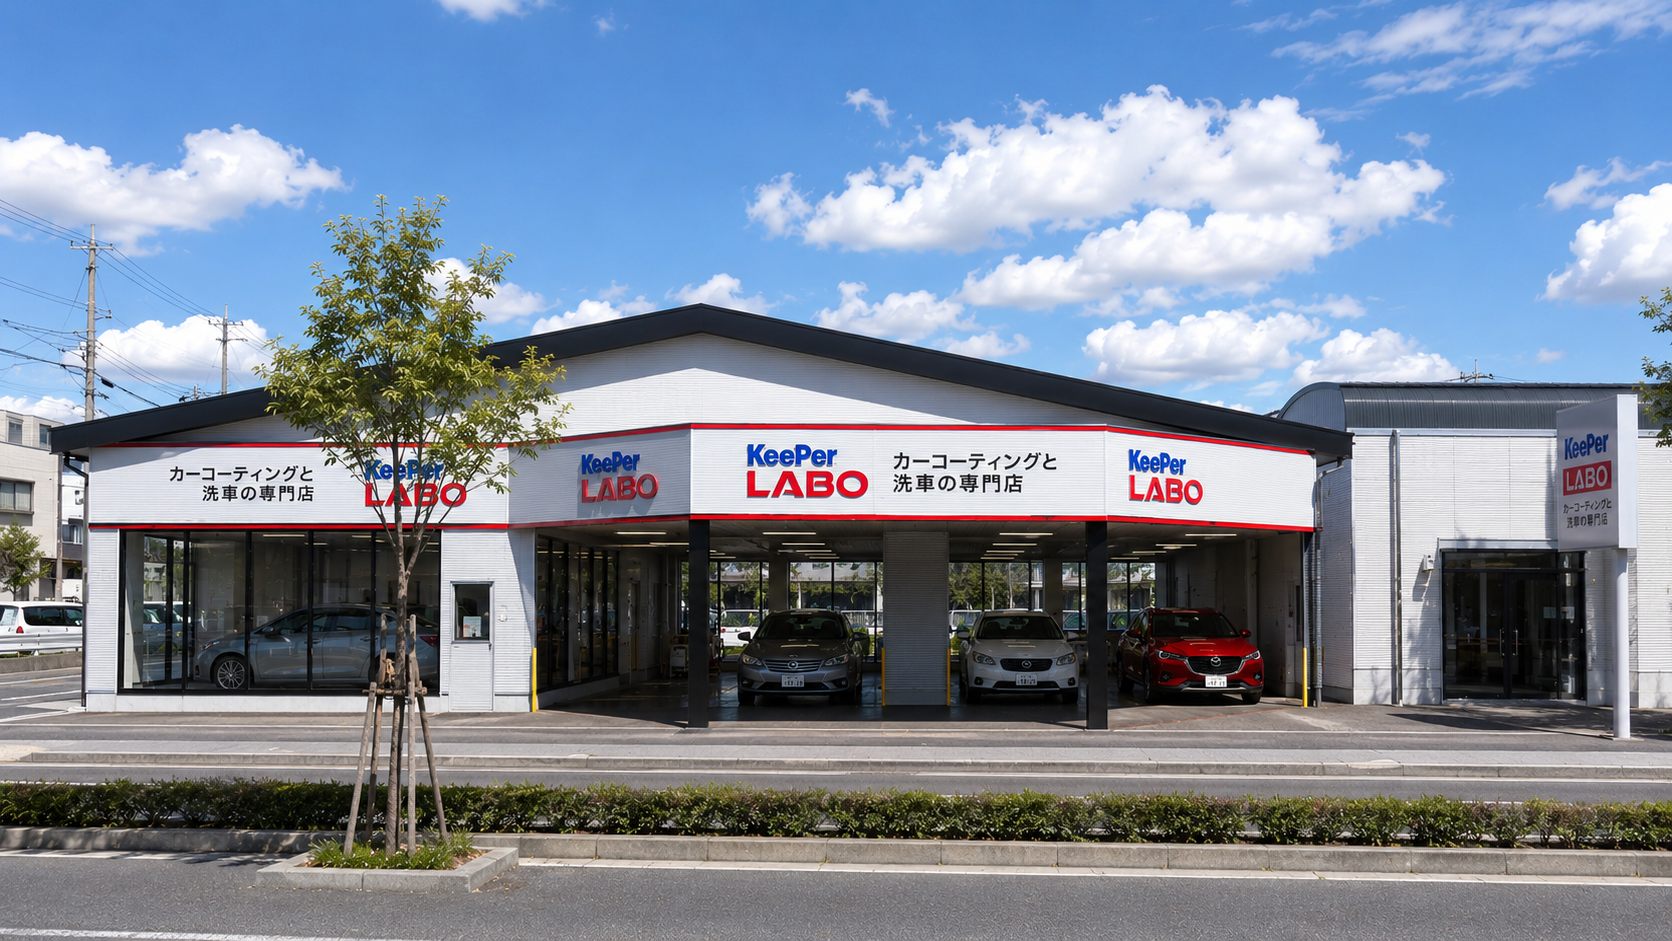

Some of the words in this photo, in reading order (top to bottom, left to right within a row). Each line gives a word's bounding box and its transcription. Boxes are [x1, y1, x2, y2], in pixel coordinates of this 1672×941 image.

[746, 444, 838, 468] KeePer
[1565, 434, 1608, 460] KeePer
[365, 459, 444, 480] KeePer
[581, 451, 641, 475] KeePer
[893, 452, 1057, 471] カーコーティングと
[1128, 449, 1186, 475] KeePer
[169, 466, 314, 482] カーコーティングと
[746, 470, 869, 499] LABO
[893, 474, 1023, 493] 洗車の専門店
[1566, 465, 1608, 491] LABO
[202, 484, 315, 502] 洗車の専門店
[365, 482, 467, 507] LABO
[581, 473, 659, 504] LABO
[1129, 475, 1203, 505] LABO
